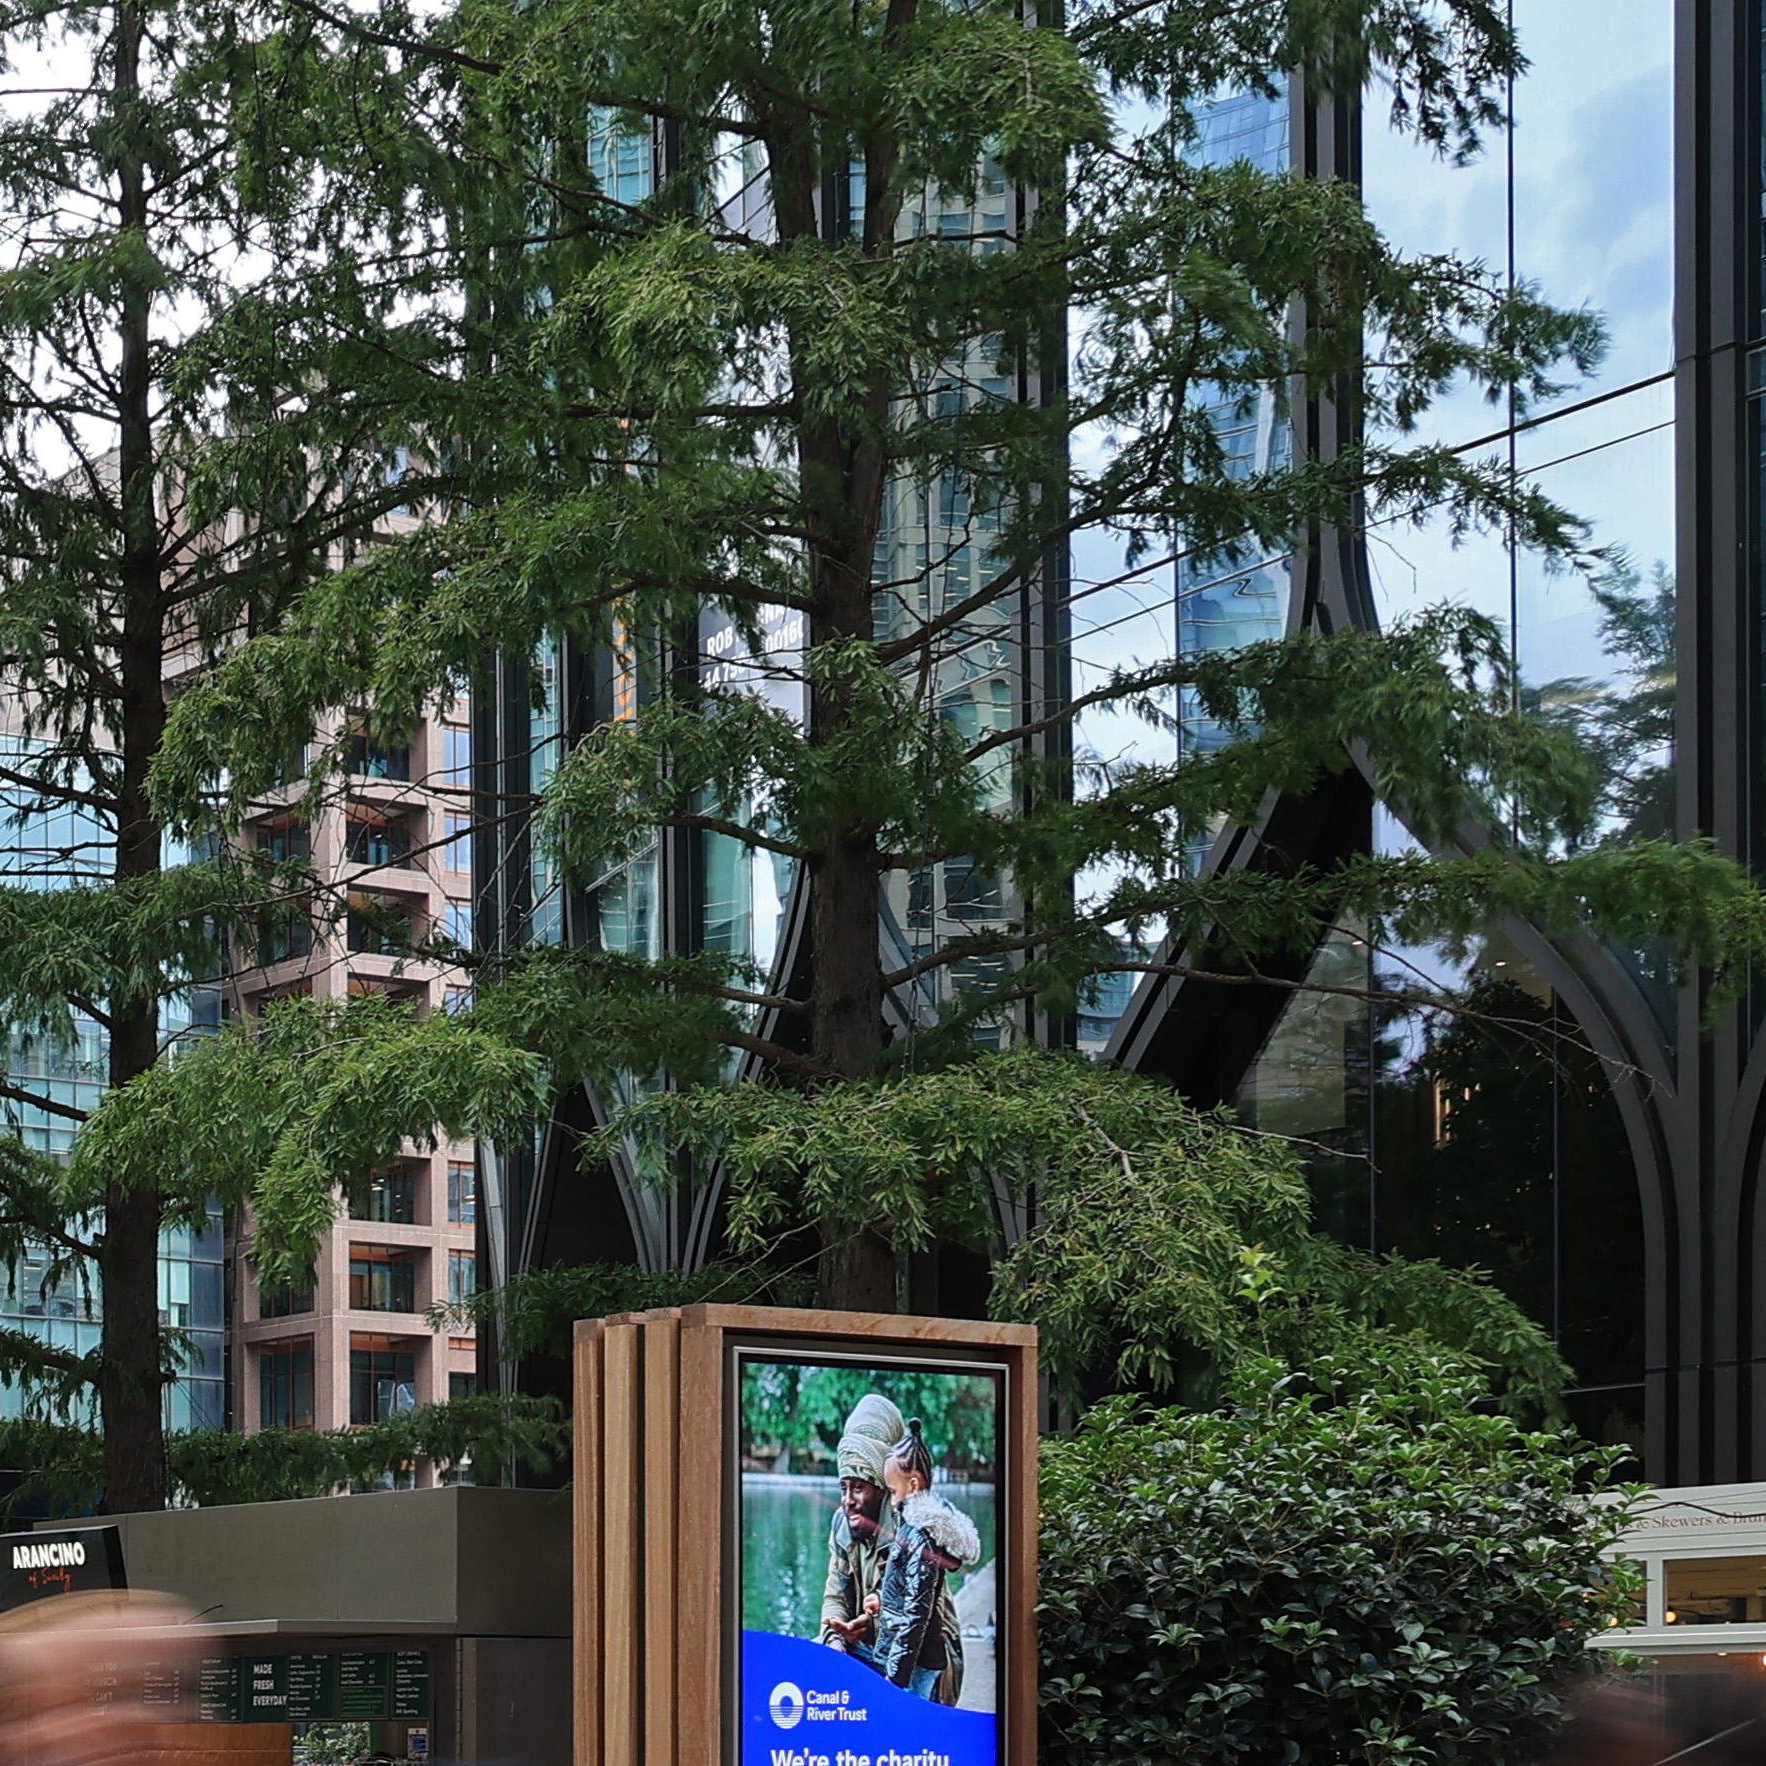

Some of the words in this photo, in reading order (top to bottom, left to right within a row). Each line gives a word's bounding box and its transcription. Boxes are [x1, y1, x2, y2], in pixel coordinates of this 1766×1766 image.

[1653, 1514, 1712, 1529] Skewers
[12, 1541, 86, 1569] ARANCINO
[253, 1664, 273, 1674] MADE
[253, 1679, 274, 1690] FRESH
[253, 1695, 287, 1706] EVERYDAY
[806, 1690, 840, 1704] Canal
[841, 1690, 850, 1704] &
[807, 1707, 837, 1720] River
[837, 1707, 867, 1720] Trust
